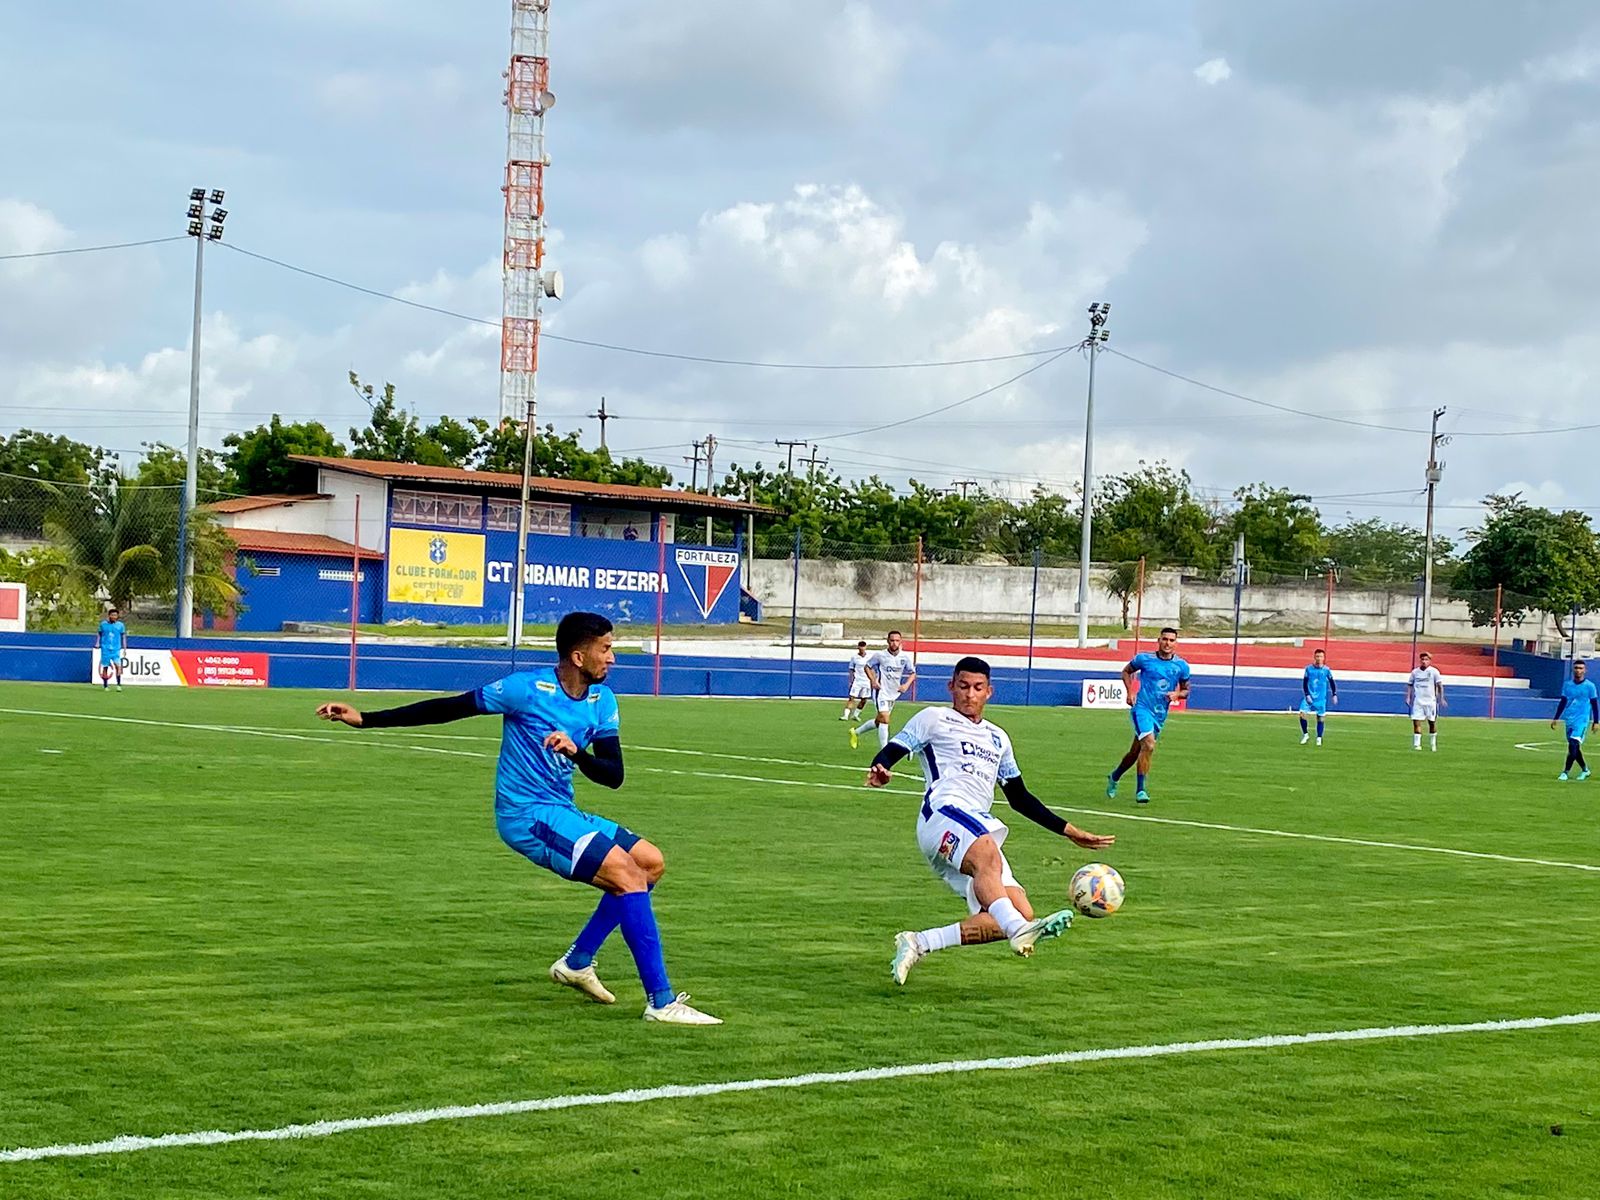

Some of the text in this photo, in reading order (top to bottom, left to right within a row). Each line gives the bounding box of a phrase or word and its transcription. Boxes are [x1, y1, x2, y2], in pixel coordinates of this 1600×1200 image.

[677, 550, 737, 564] FORTALEZA
[395, 565, 427, 578] CLUBE
[487, 560, 513, 583] CT
[595, 568, 670, 594] BEZERRA
[120, 655, 161, 676] Pulse
[1098, 684, 1122, 700] Pulse
